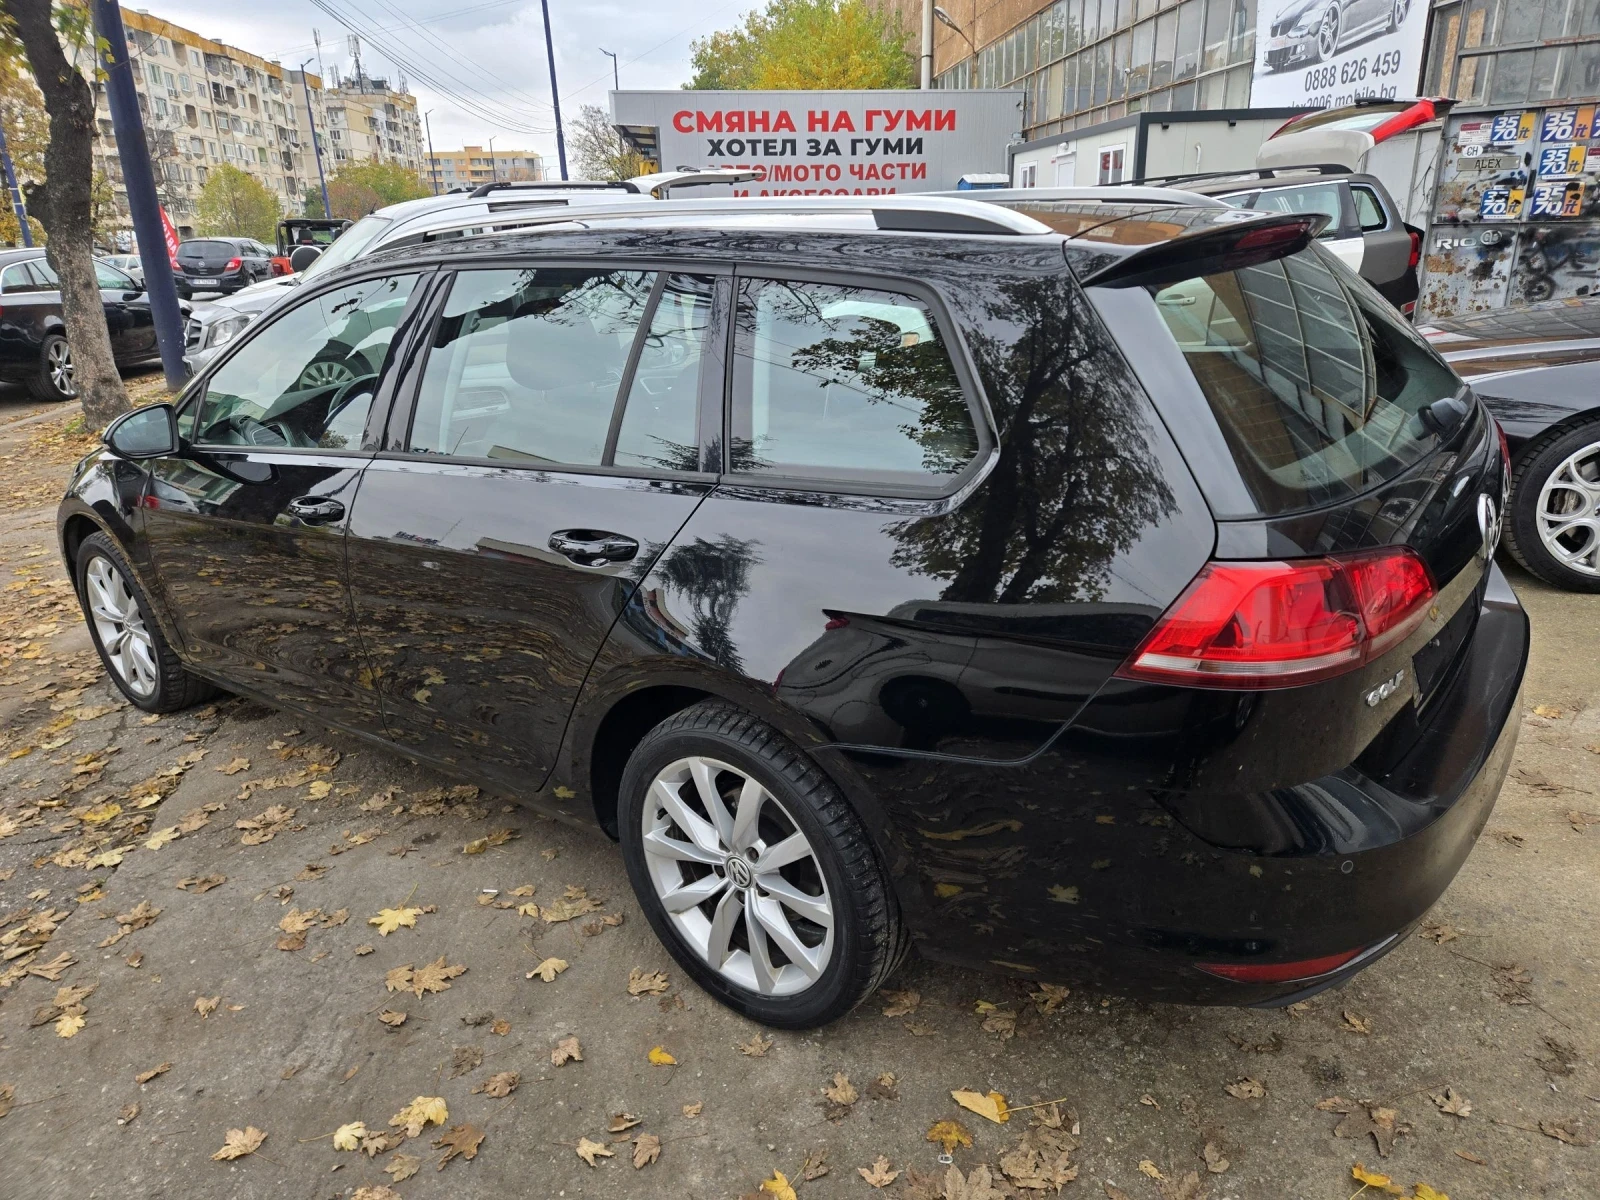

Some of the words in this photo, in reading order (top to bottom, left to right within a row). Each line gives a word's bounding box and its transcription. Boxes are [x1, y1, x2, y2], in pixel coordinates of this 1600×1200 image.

[1305, 65, 1337, 92] 0888
[1341, 57, 1367, 84] 626
[1371, 49, 1401, 78] 459
[672, 110, 796, 133] СМЯНА
[808, 110, 855, 132] НА
[865, 109, 957, 132] ГУМИ
[1497, 116, 1520, 129] 35
[1546, 111, 1577, 127] 35
[707, 138, 797, 157] ХОТЕЛ
[806, 138, 842, 156] ЗА
[850, 137, 923, 156] ГУМИ
[1543, 149, 1569, 162] 35
[708, 164, 841, 182] О/МОТО
[850, 162, 927, 180] ЧАСТИ
[1474, 158, 1502, 170] ALEX
[1436, 237, 1477, 249] RIO
[1366, 669, 1404, 707] GOLF
